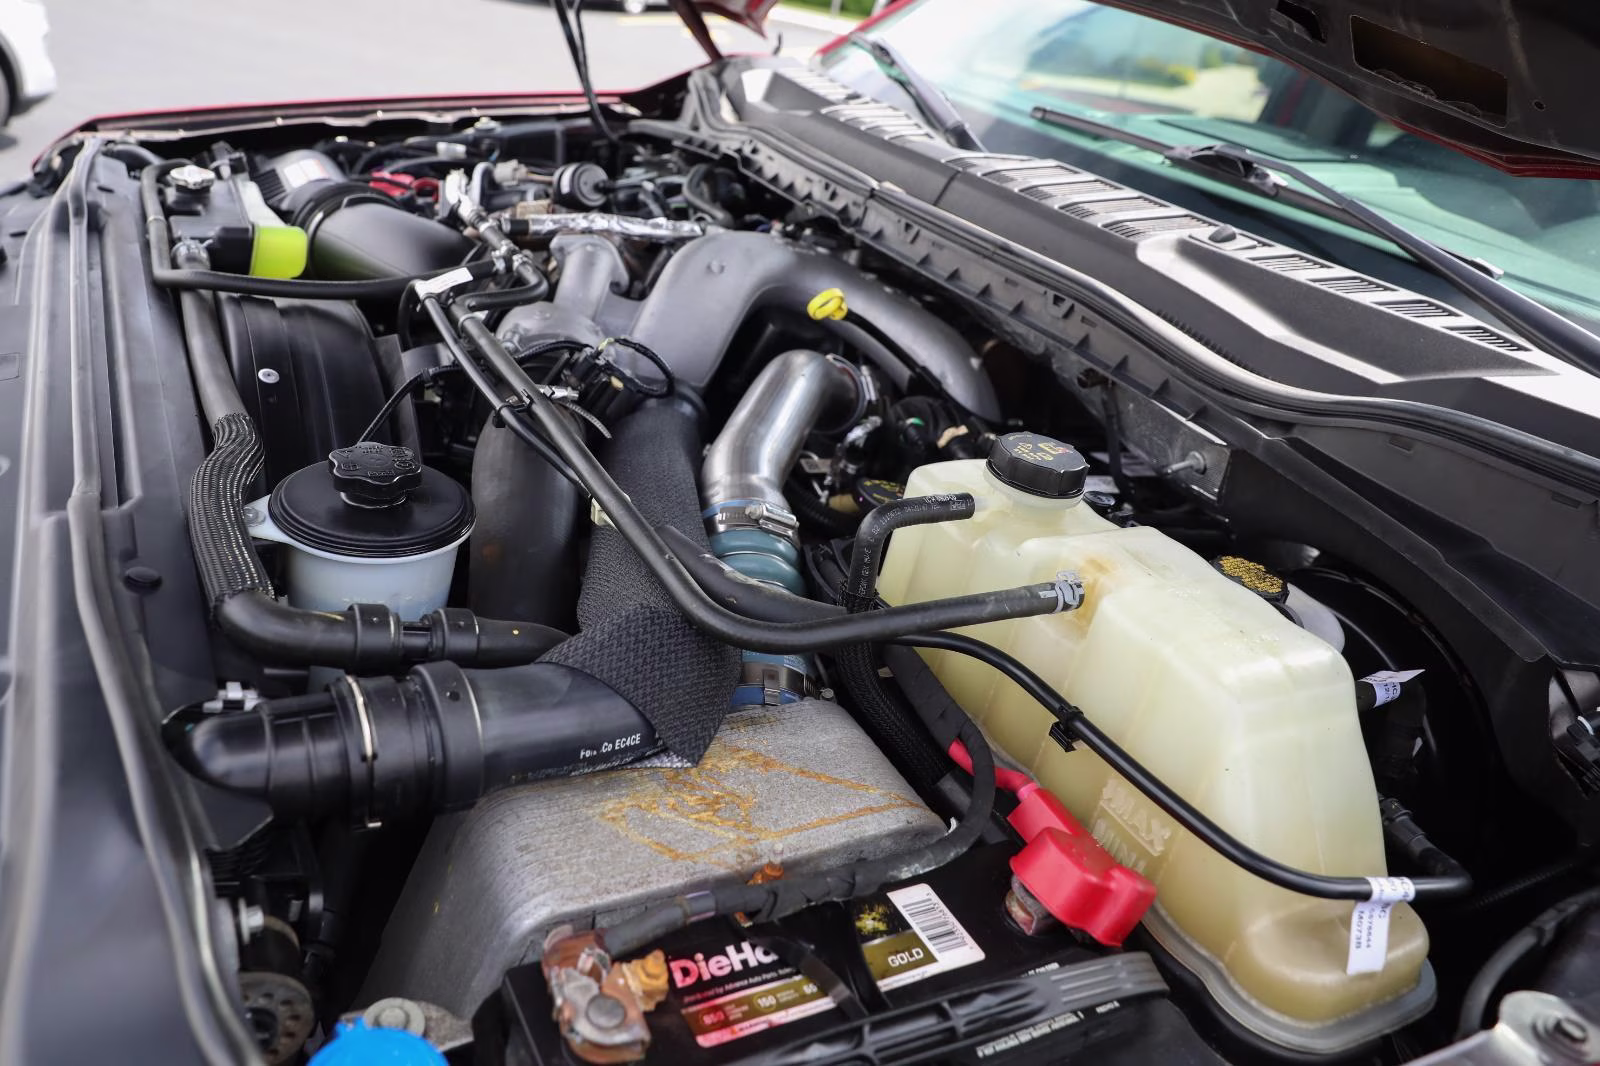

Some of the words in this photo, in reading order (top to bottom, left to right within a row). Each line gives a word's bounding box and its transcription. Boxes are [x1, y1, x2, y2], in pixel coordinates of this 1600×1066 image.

[614, 733, 642, 751] EC4CE
[669, 940, 780, 989] DieHa
[887, 947, 925, 968] GOLD
